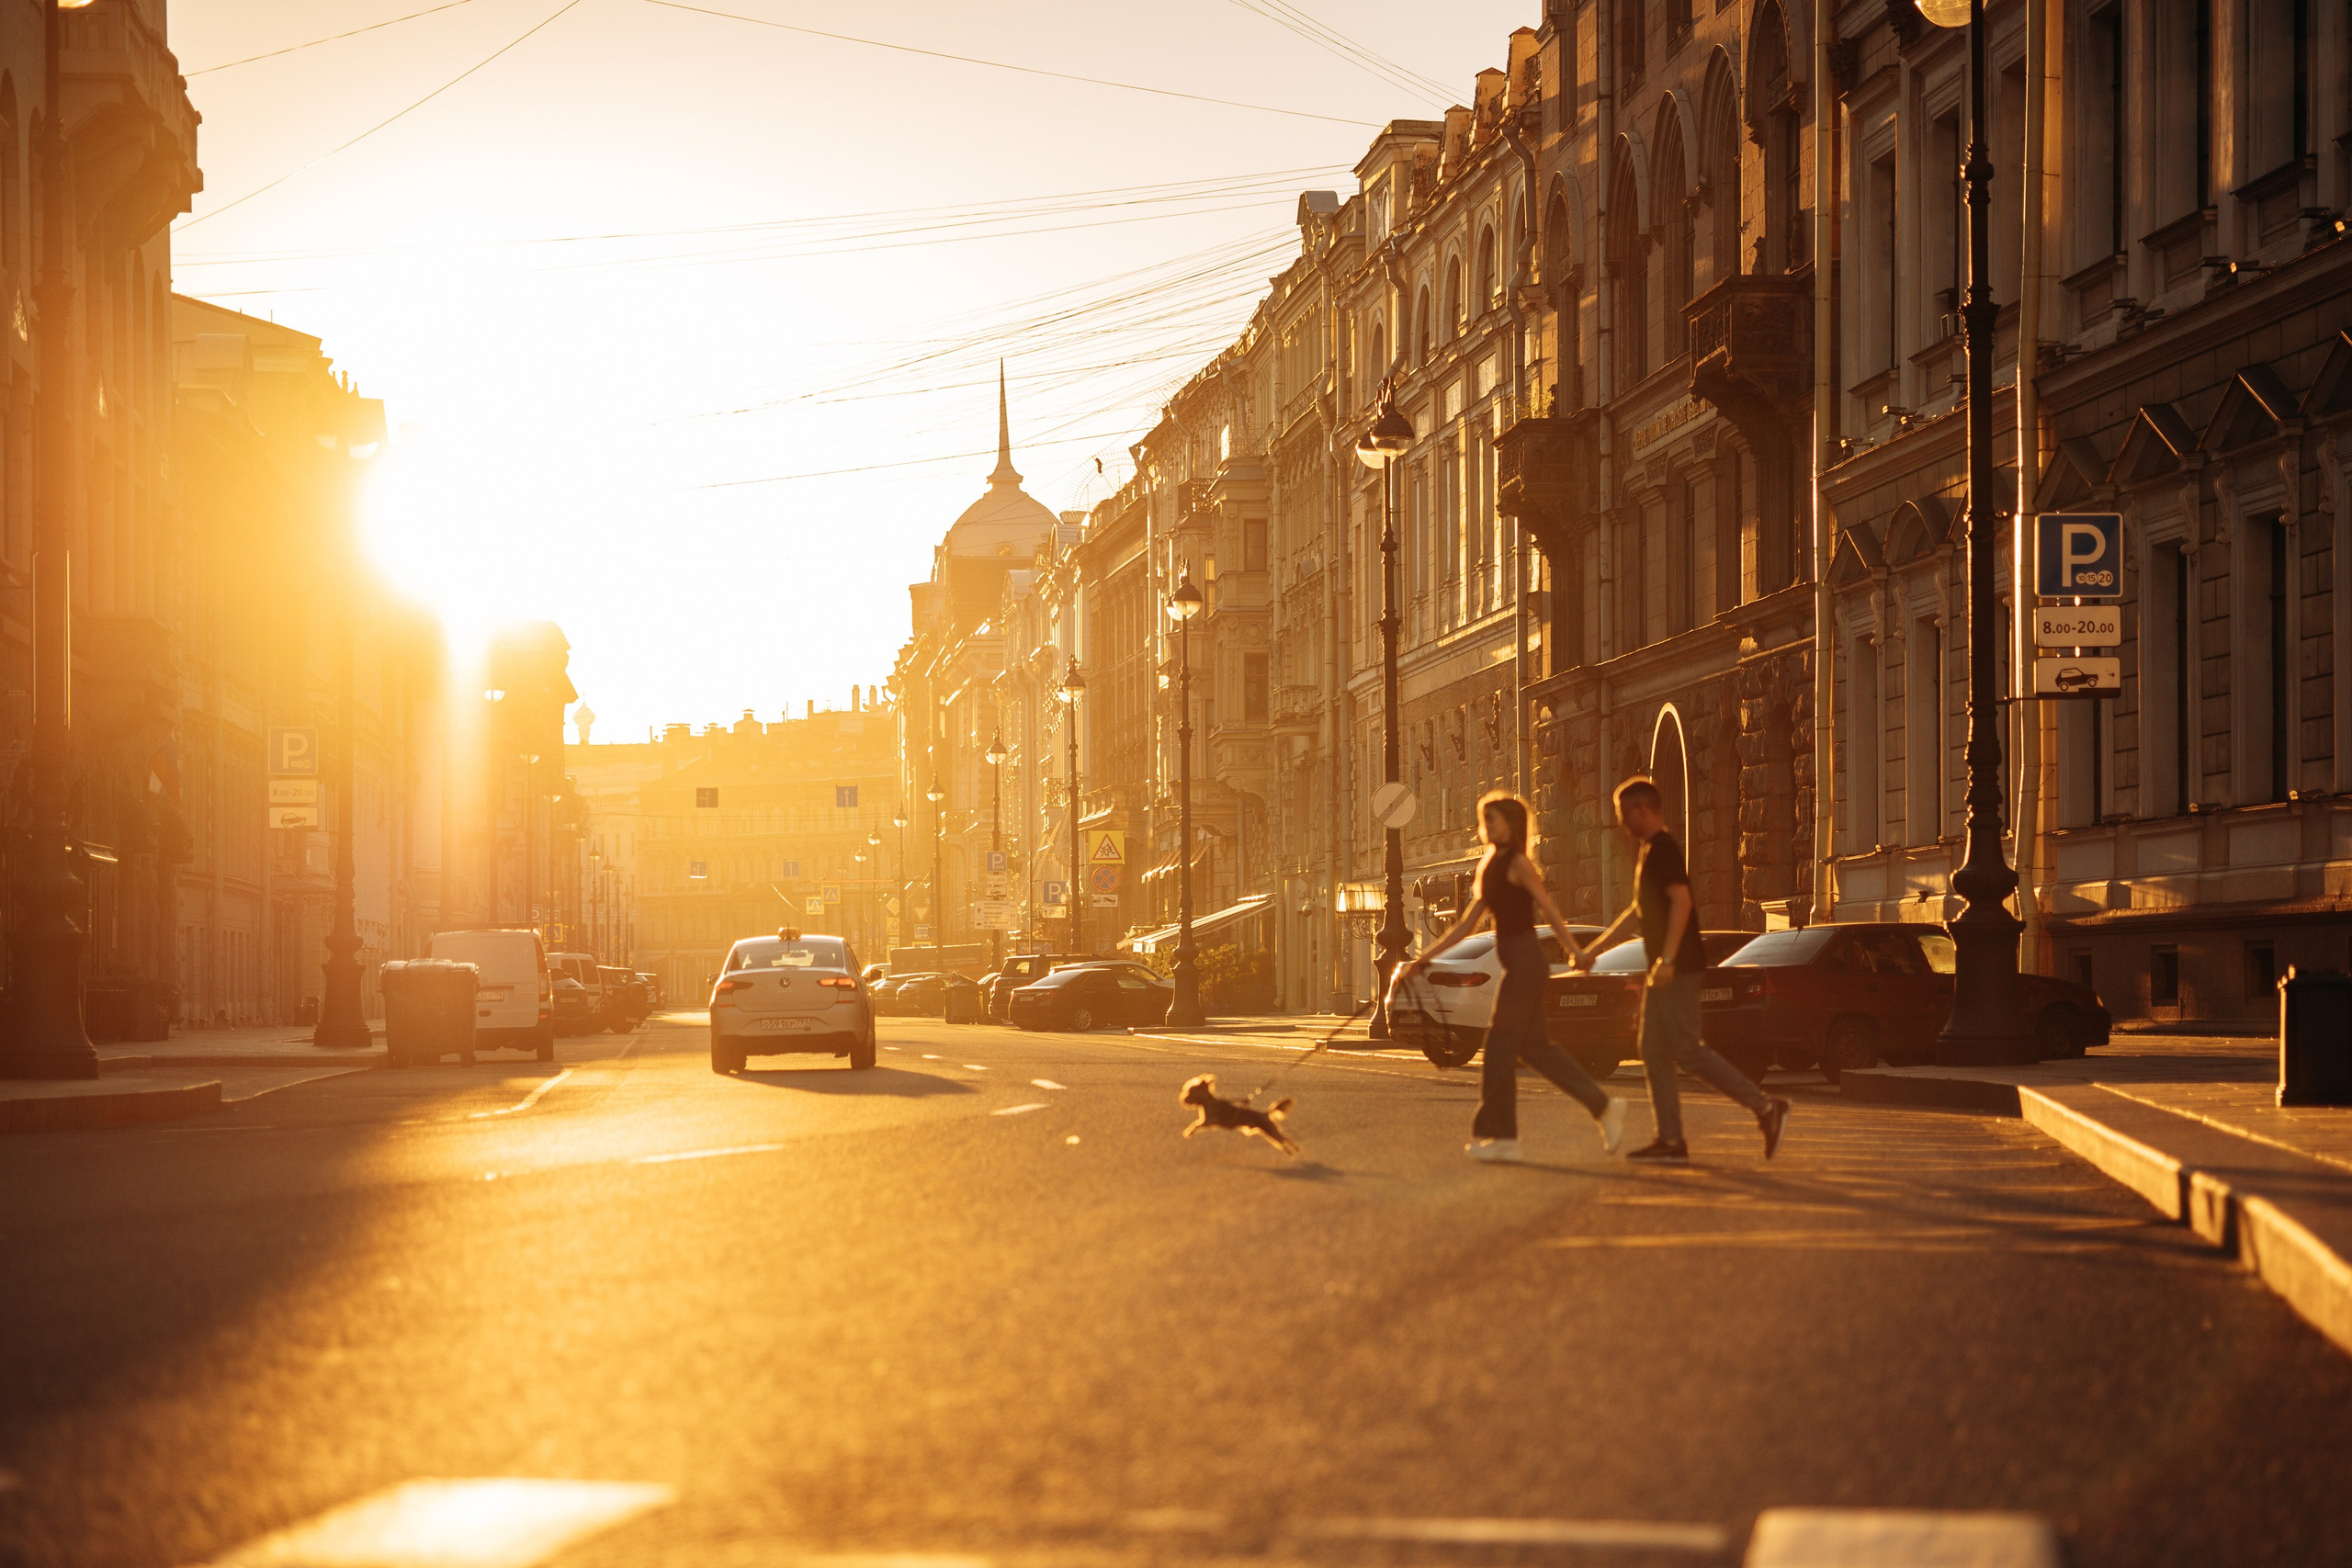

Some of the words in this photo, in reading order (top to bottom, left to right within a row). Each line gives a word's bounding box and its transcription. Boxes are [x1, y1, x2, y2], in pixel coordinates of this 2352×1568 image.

[2062, 524, 2107, 587] P
[2087, 574, 2097, 582] 15
[2098, 573, 2112, 583] 20
[2042, 620, 2115, 635] 8.00-20.00
[282, 733, 309, 769] P
[272, 788, 314, 797] 8.00-20.00
[992, 853, 1003, 870] P
[1048, 883, 1062, 902] P
